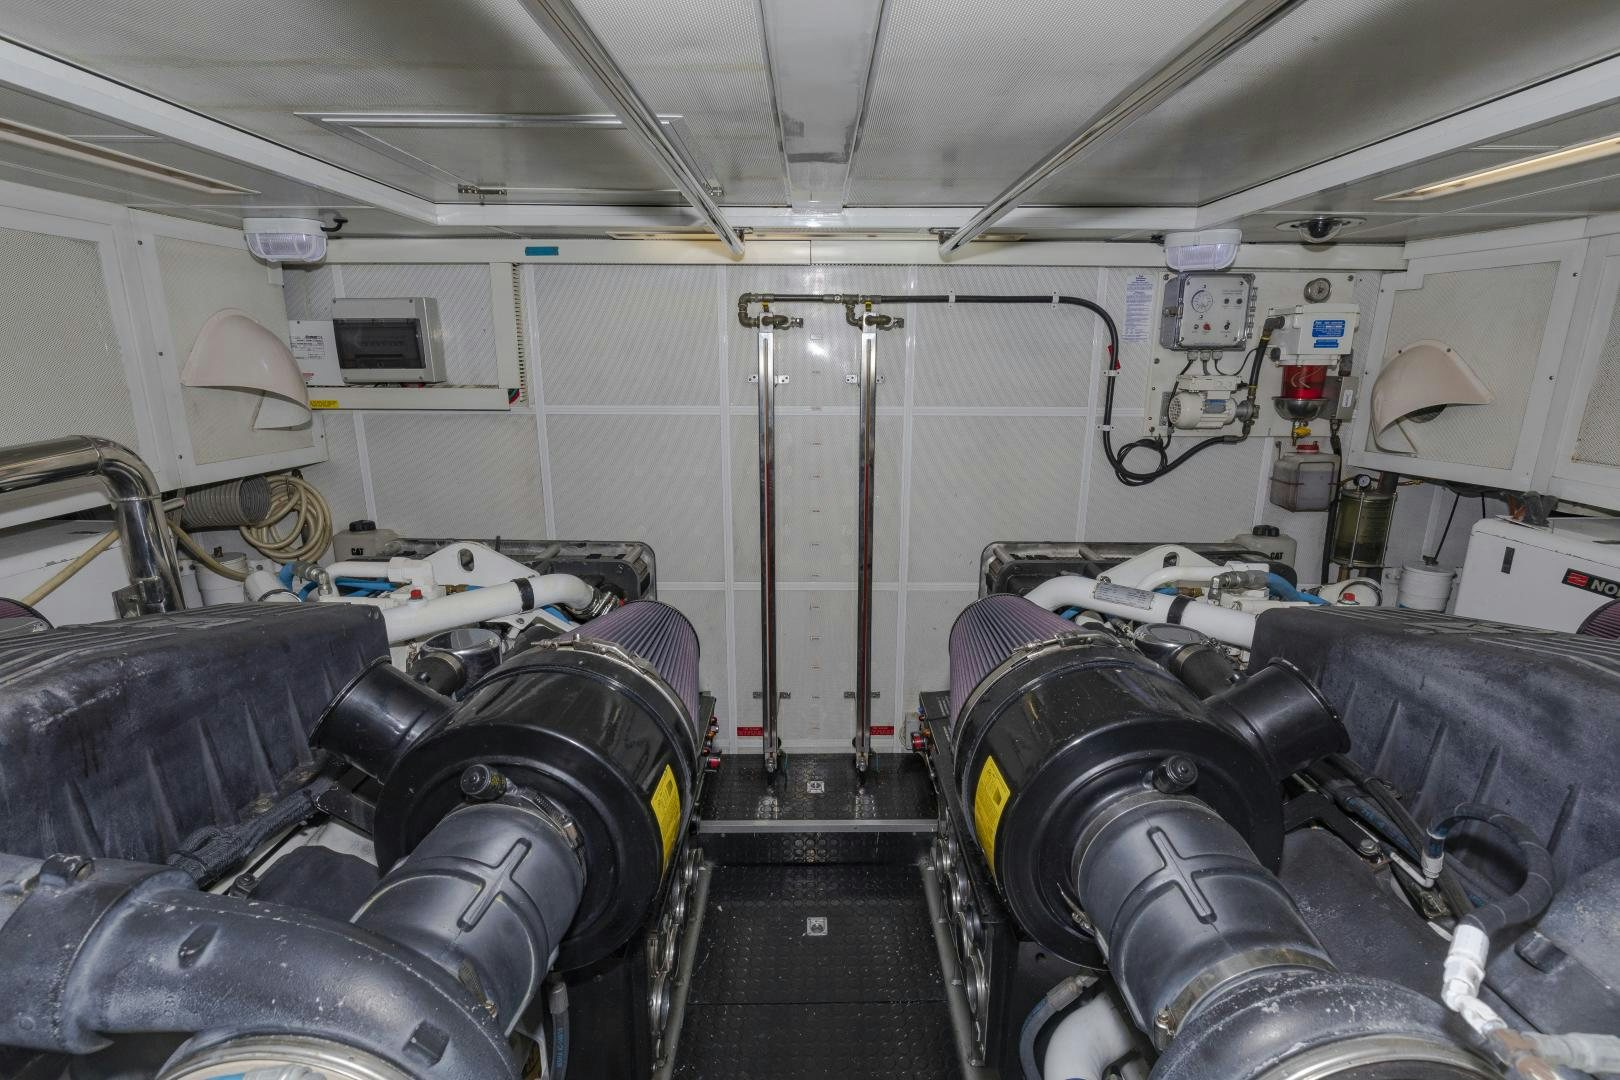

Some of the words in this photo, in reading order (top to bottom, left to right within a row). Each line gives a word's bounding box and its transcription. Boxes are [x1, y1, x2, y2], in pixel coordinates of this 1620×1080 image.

[351, 548, 363, 556] CAT
[1270, 552, 1283, 560] CAT
[1591, 579, 1620, 597] NO
